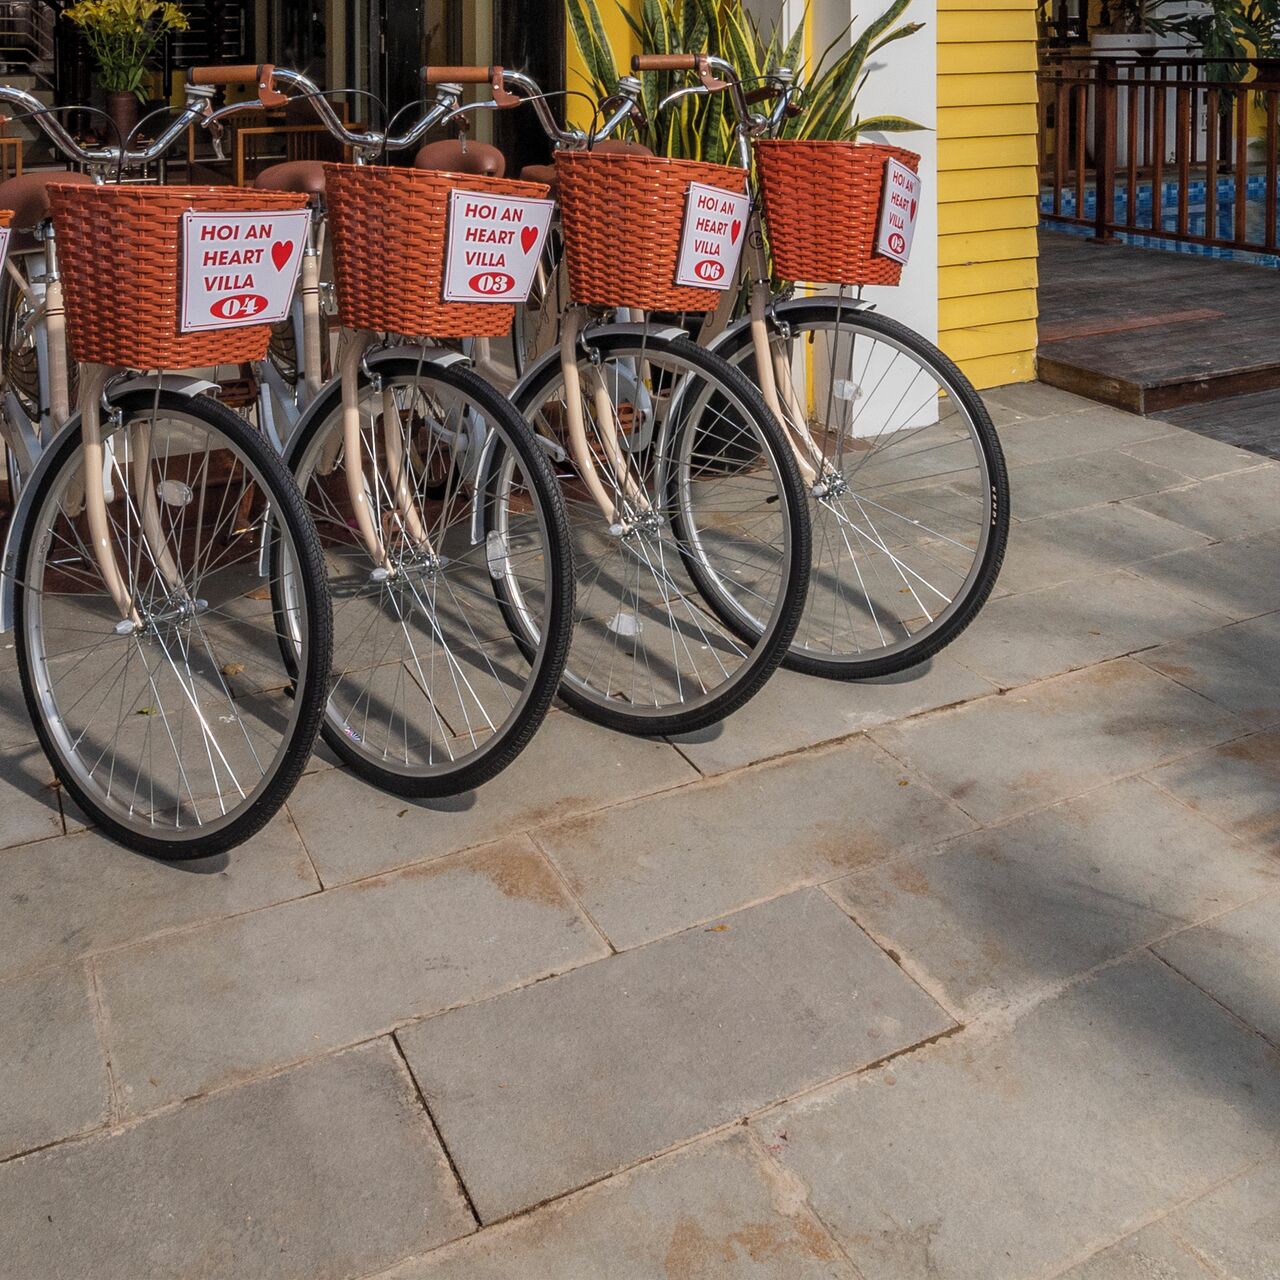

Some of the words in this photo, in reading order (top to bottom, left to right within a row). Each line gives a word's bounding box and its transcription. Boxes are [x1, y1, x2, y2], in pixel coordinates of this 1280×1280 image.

[893, 171, 905, 186] HOI
[905, 180, 913, 193] AN
[697, 195, 718, 212] HOI
[720, 201, 735, 215] AN
[891, 192, 909, 212] HEART
[465, 203, 497, 219] HOI
[500, 208, 523, 222] AN
[696, 217, 728, 235] HEART
[889, 212, 904, 231] VILLA
[201, 225, 239, 240] HOI
[245, 224, 272, 239] AN
[466, 228, 515, 244] HEART
[695, 240, 720, 256] VILLA
[891, 237, 904, 253] 02
[203, 249, 264, 266] HEART
[466, 251, 506, 267] VILLA
[700, 262, 721, 279] 06
[204, 274, 254, 291] VILLA
[478, 275, 508, 292] 03
[222, 297, 258, 316] 04
